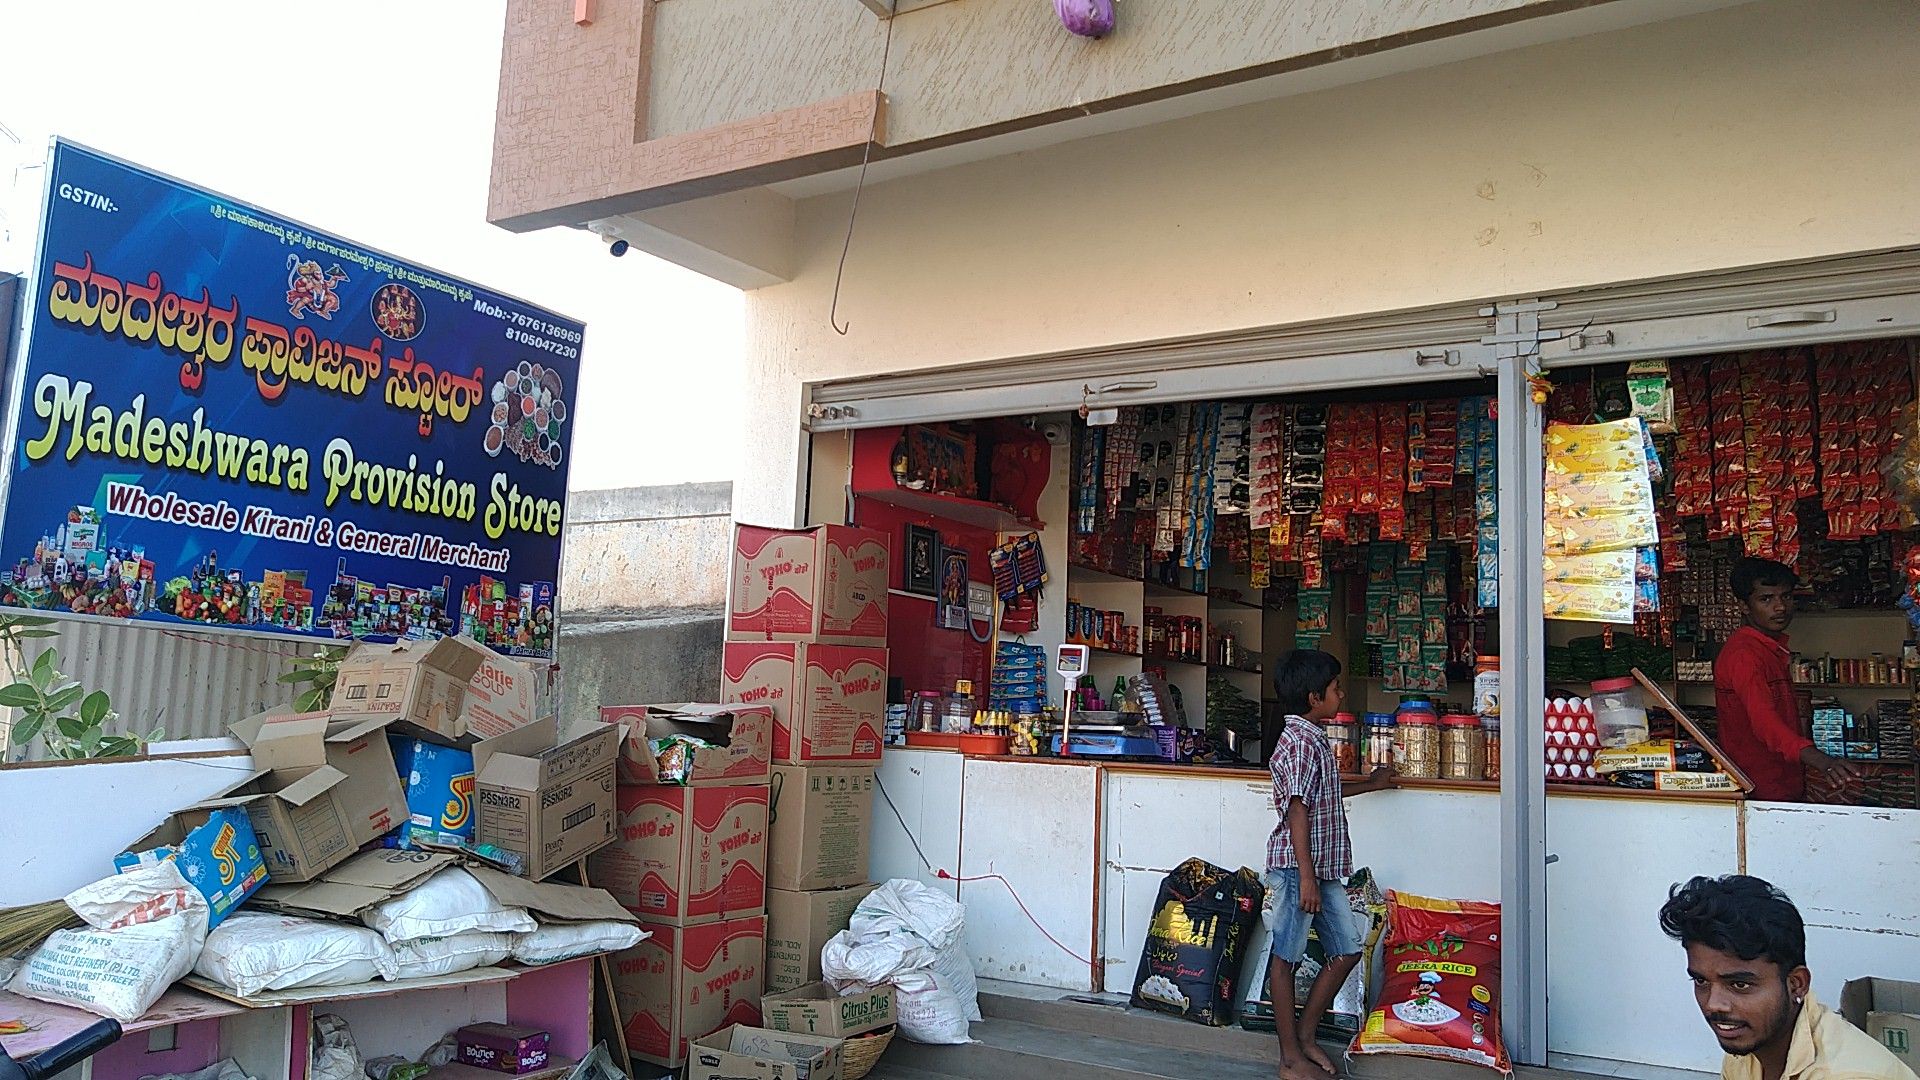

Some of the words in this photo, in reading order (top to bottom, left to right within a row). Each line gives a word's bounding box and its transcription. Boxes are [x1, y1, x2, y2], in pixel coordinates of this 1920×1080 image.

[58, 184, 119, 213] GSTIN:-
[49, 250, 239, 391] ಮಾದೇಶ್ವರ
[505, 327, 578, 359] 8105047230
[25, 373, 308, 491] Madeshwara
[324, 438, 476, 520] Provision
[484, 472, 562, 538] Store
[107, 484, 236, 530] Wholesale
[243, 506, 314, 543] Kirani
[317, 524, 332, 545] &
[338, 528, 416, 559] General
[421, 537, 510, 572] Merchant
[759, 561, 793, 579] YOHO
[739, 685, 768, 703] YOHO
[841, 676, 869, 697] YOHO
[480, 791, 521, 809] PSSN3R2
[541, 786, 573, 809] PSSN3R2
[623, 819, 657, 843] YOHO
[718, 831, 749, 854] YOHO
[87, 936, 113, 947] PKTS
[1175, 923, 1207, 946] Rice
[74, 955, 110, 971] REFINERY
[617, 957, 649, 976] YOHO
[1174, 963, 1207, 978] Special
[1400, 963, 1438, 972] JEERA
[1441, 963, 1473, 975] RICE
[705, 970, 740, 994] YOHO
[841, 1001, 868, 1020] Citrus
[870, 994, 889, 1012] Plus
[466, 1045, 495, 1059] BOUNCE
[521, 1052, 547, 1066] BOUNCE
